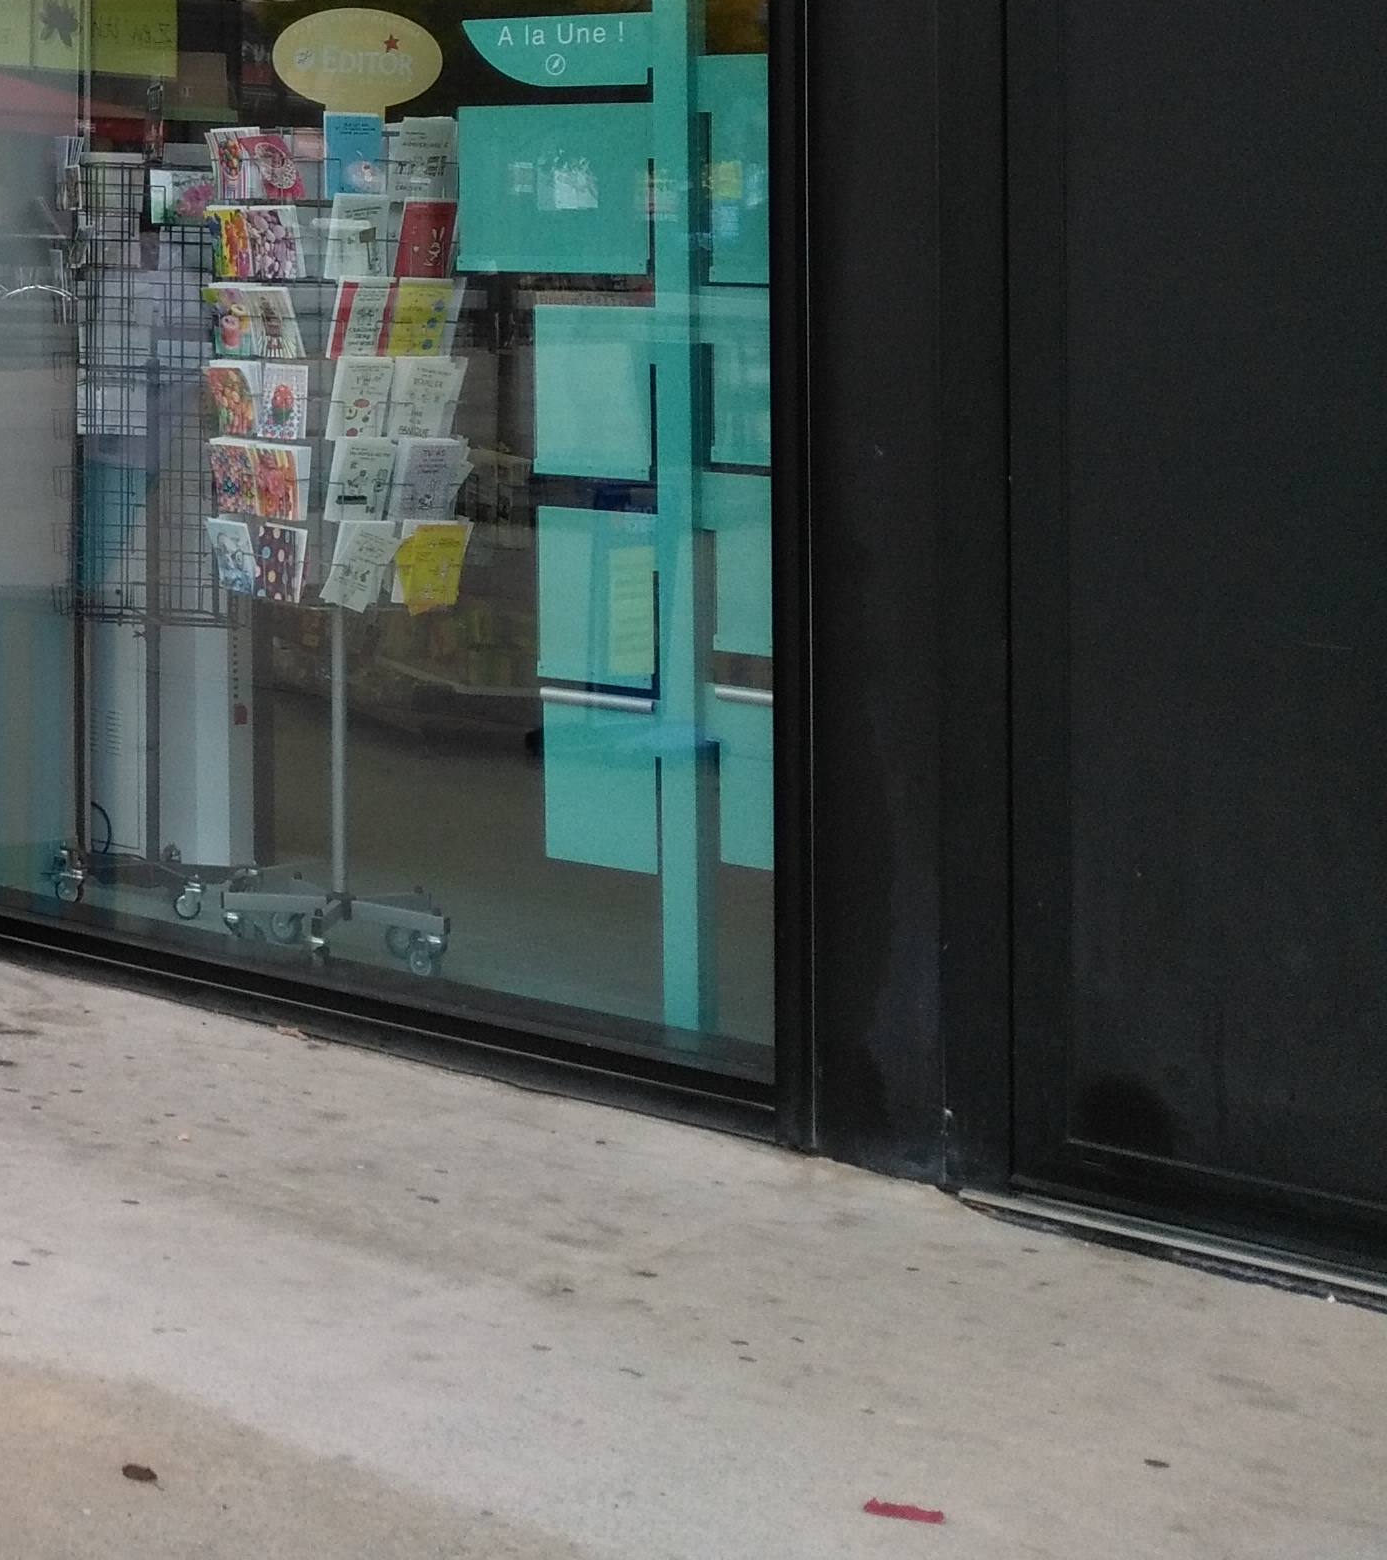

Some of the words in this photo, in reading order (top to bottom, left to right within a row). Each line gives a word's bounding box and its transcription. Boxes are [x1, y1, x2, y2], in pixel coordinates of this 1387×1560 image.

[497, 25, 514, 46] A
[525, 24, 546, 45] la
[557, 22, 606, 44] Une
